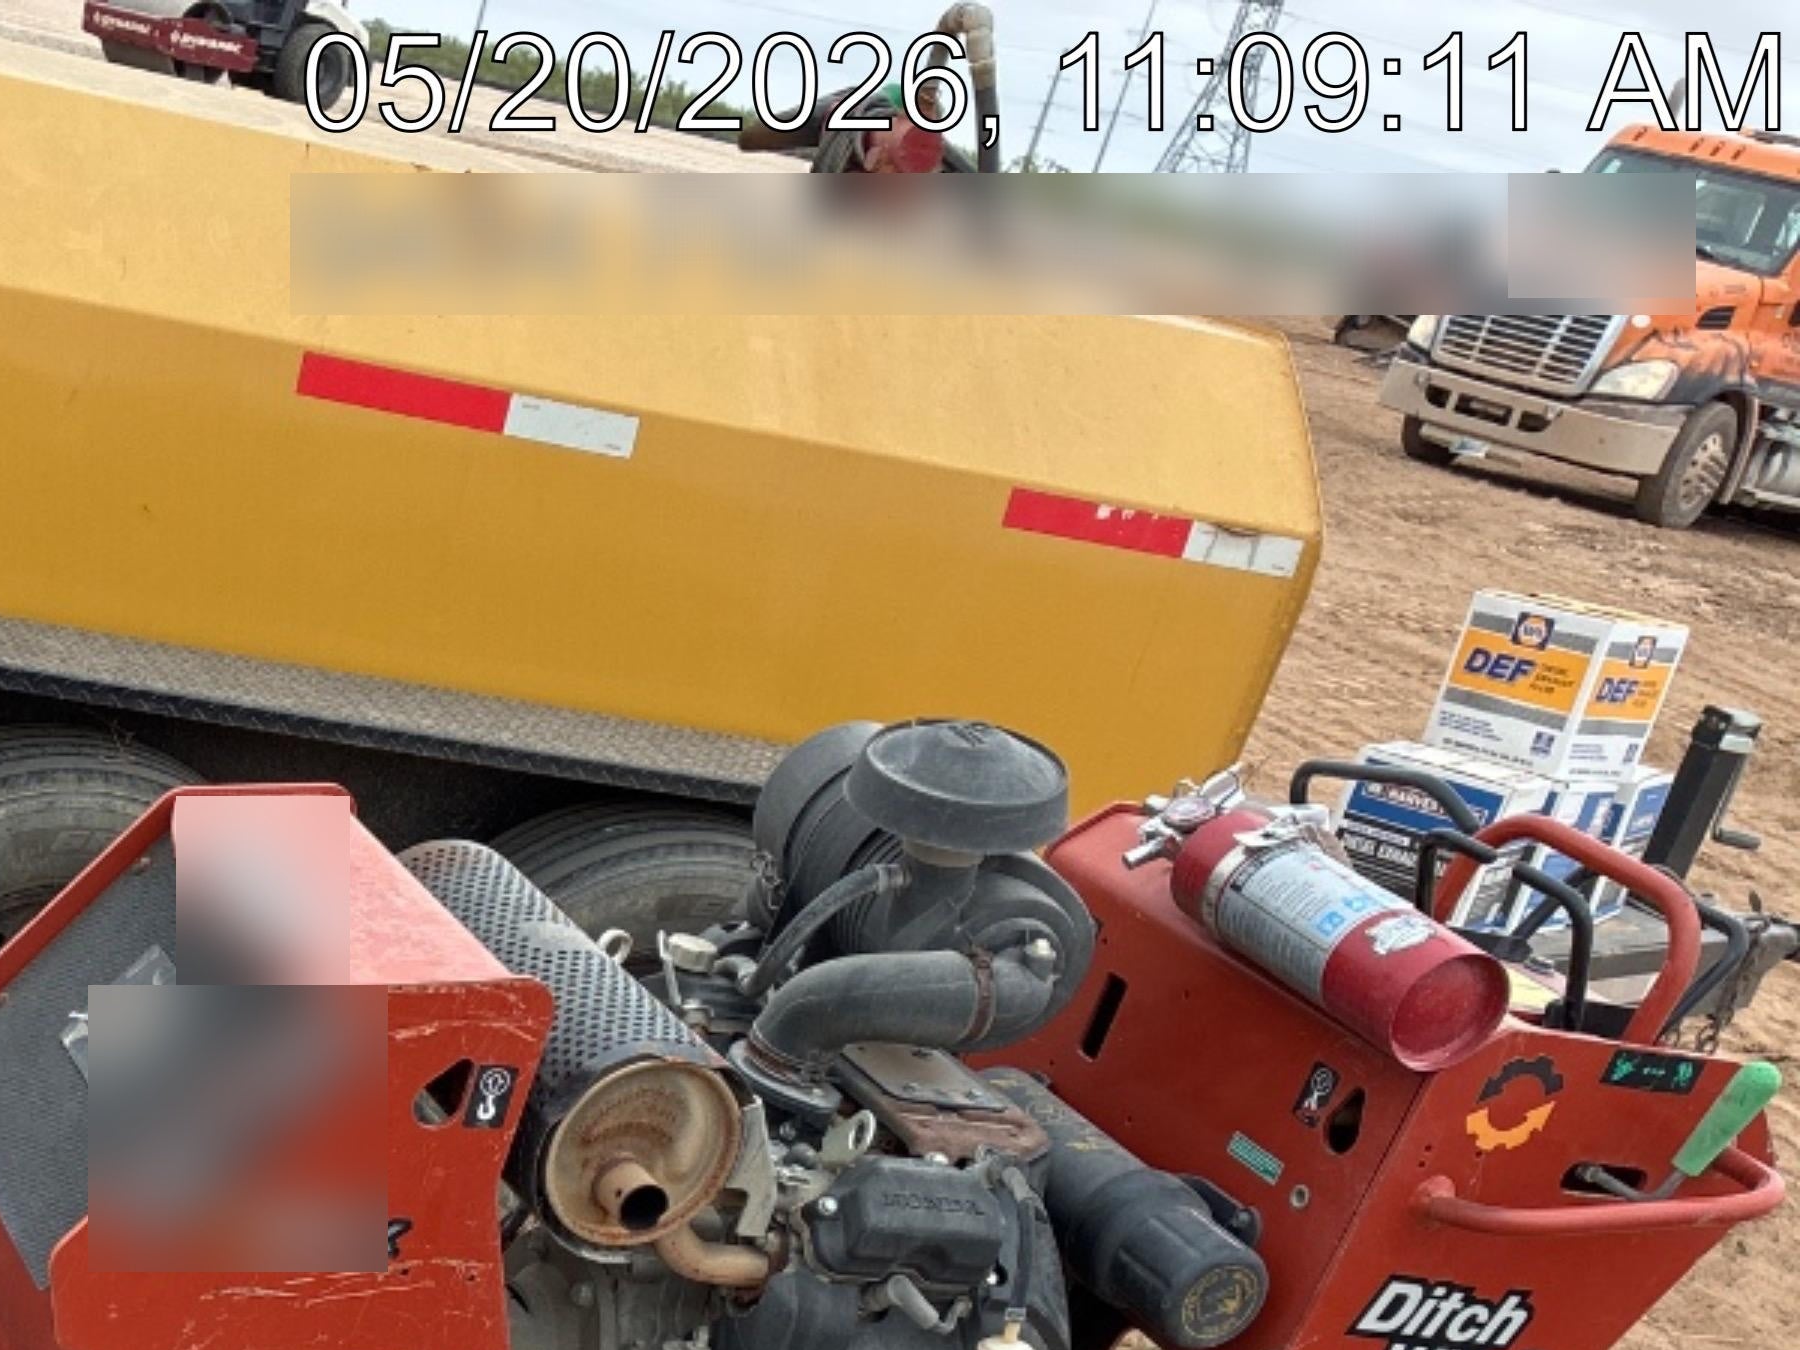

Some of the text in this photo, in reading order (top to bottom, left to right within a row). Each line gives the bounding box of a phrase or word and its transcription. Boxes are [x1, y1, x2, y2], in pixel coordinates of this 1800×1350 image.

[1463, 647, 1538, 683] DEF
[1595, 677, 1640, 703] DEF
[1354, 1279, 1529, 1346] Ditch
